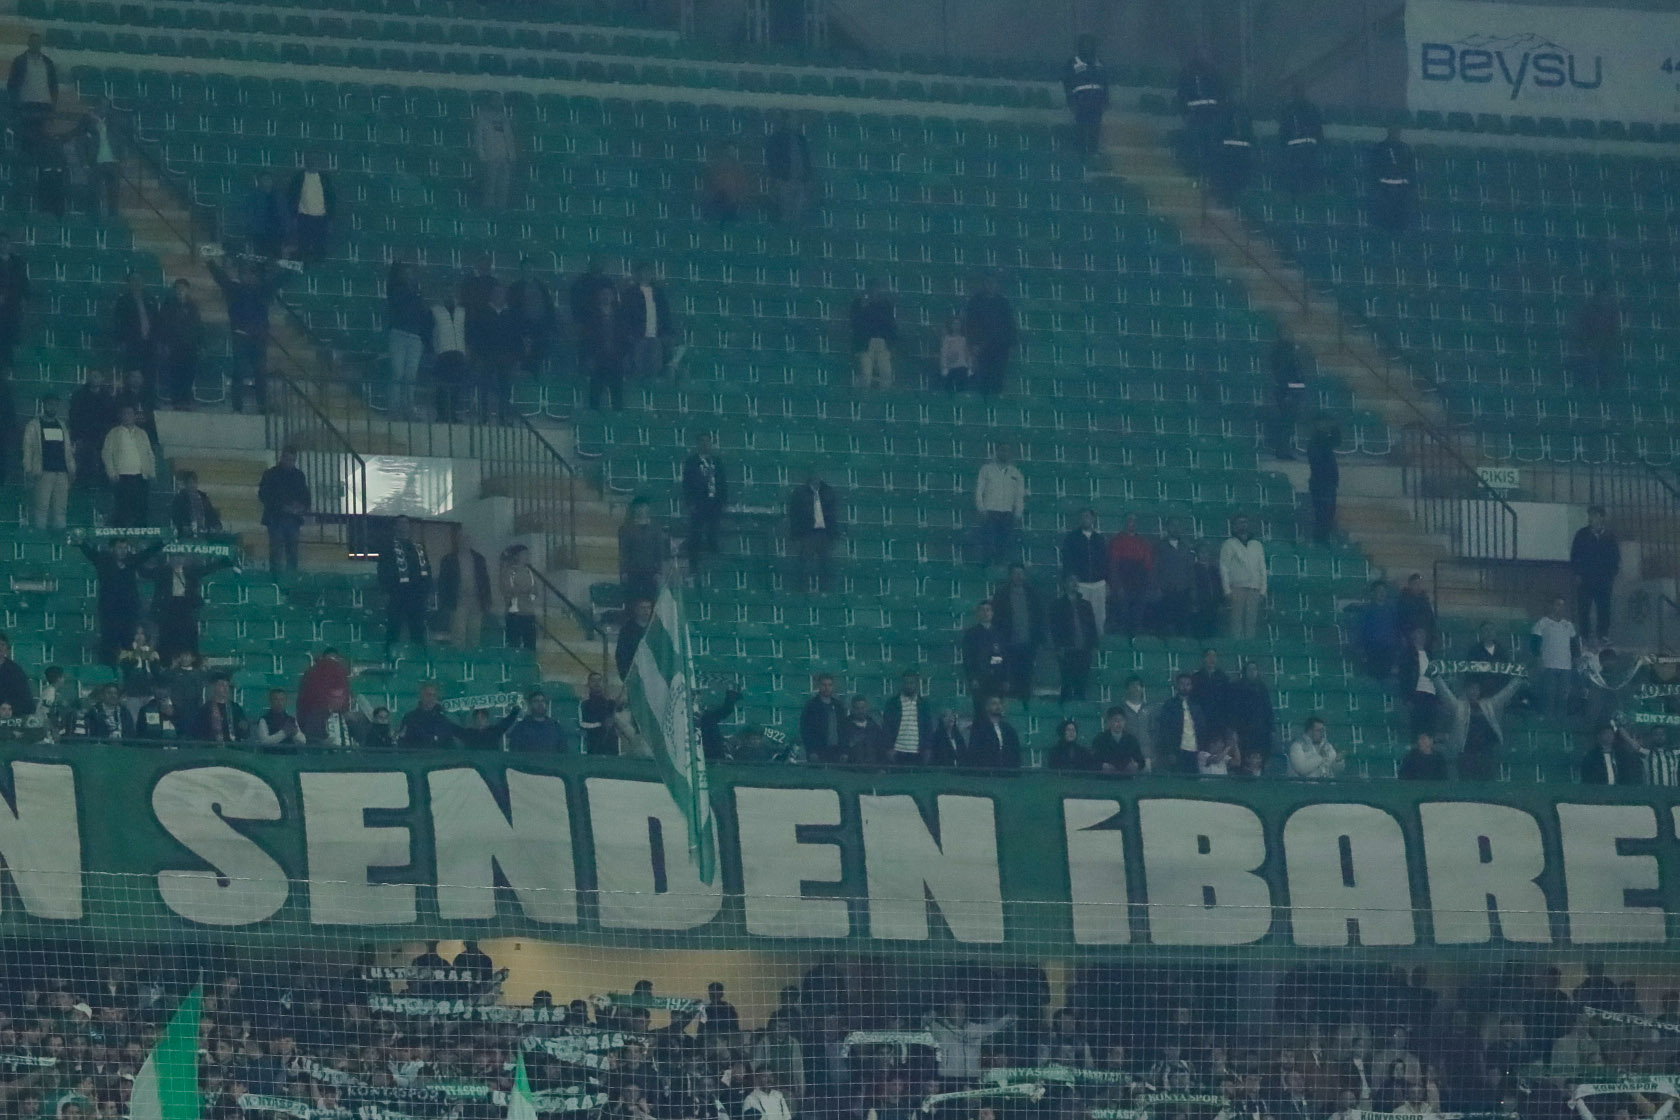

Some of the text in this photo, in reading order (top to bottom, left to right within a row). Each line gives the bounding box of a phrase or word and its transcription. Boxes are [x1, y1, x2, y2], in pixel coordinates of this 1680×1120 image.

[1421, 43, 1602, 100] Beysu
[94, 527, 160, 537] KONYASPOR
[162, 544, 230, 556] KONYASPOR
[763, 726, 784, 742] 1922
[151, 765, 1004, 944] SENDEN
[1064, 795, 1680, 946] İBARE
[1149, 1094, 1219, 1104] KONYASPOR
